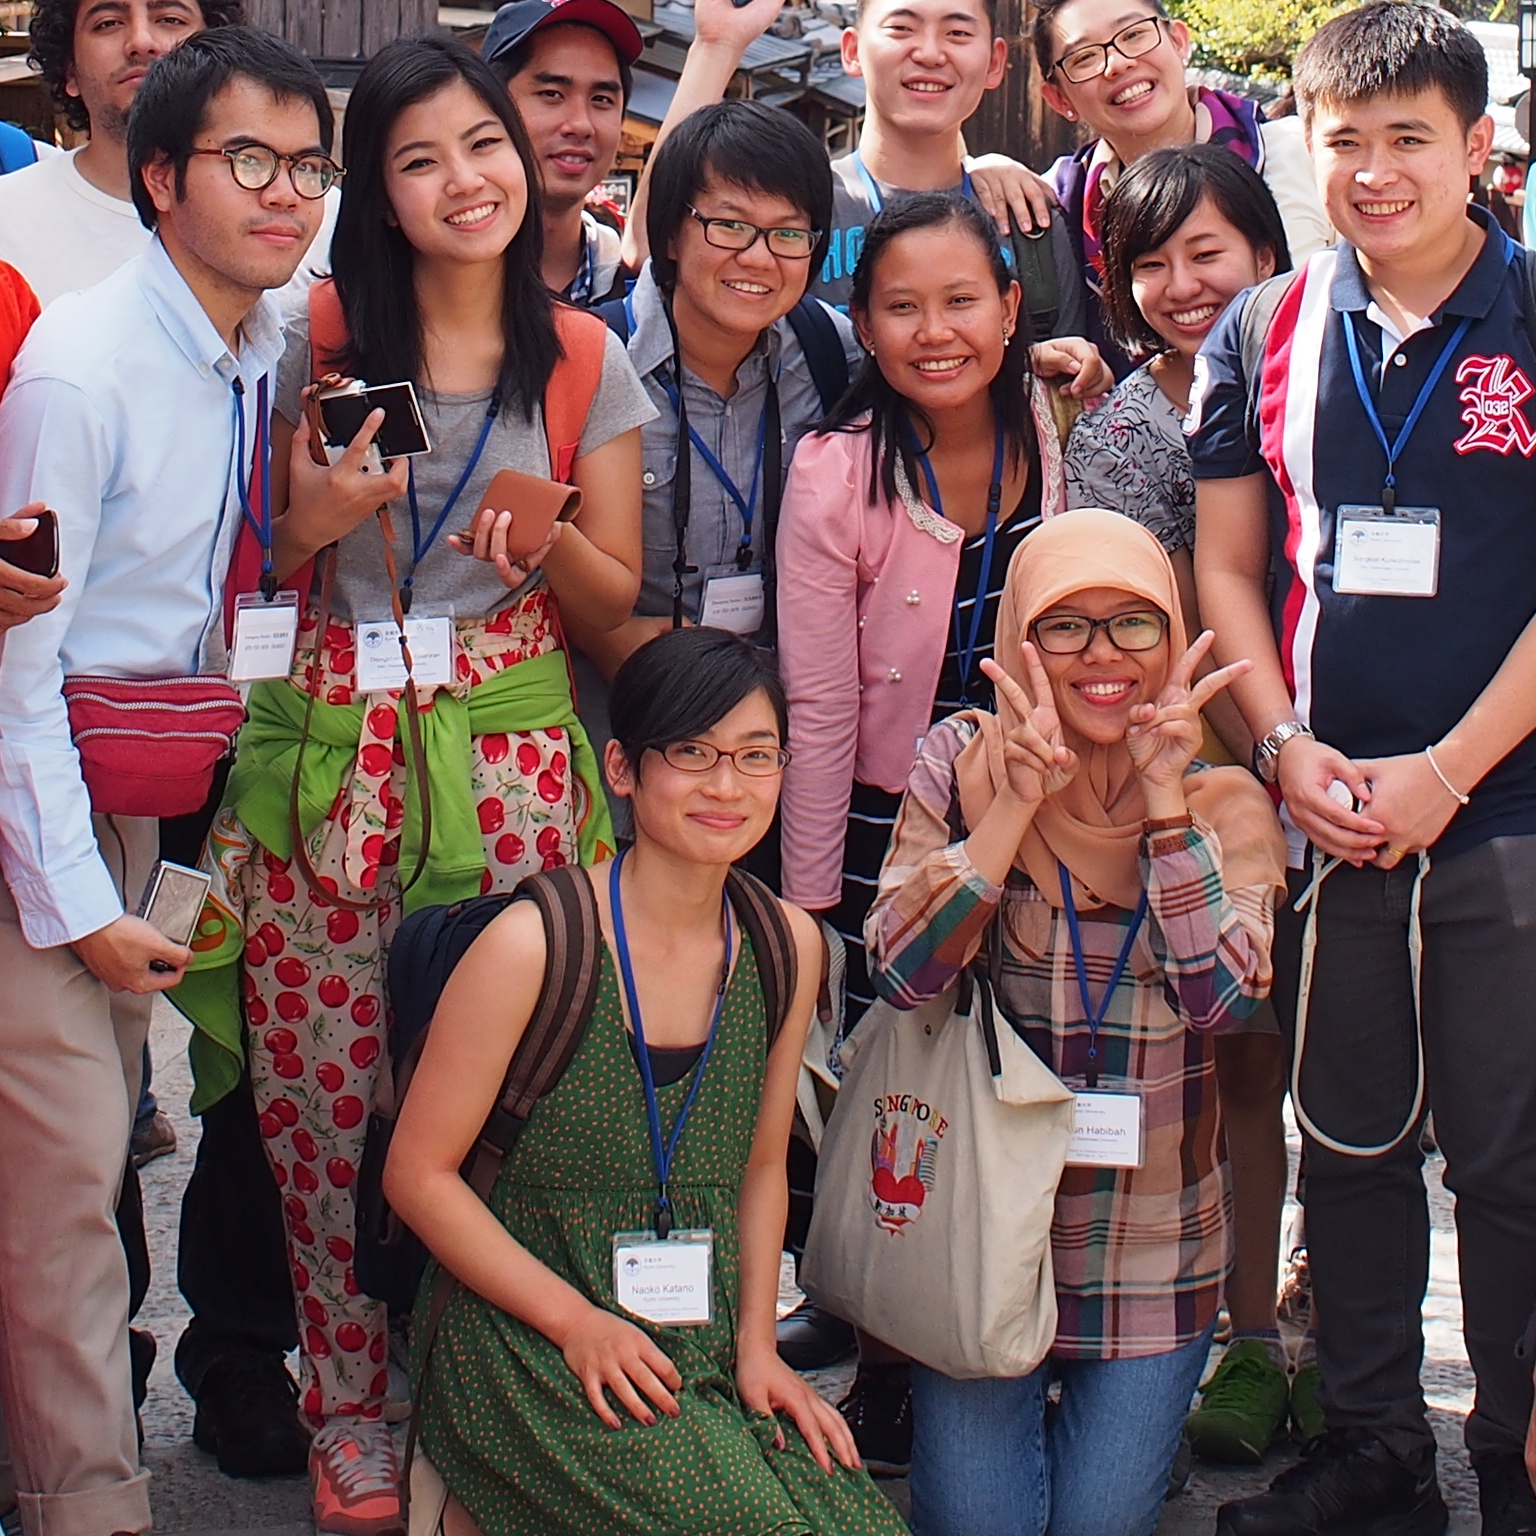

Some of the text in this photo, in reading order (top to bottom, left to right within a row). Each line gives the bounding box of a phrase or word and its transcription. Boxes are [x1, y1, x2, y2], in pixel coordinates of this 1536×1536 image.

[1086, 1126, 1126, 1136] Habibah
[632, 1284, 695, 1294] Naoko Katano
